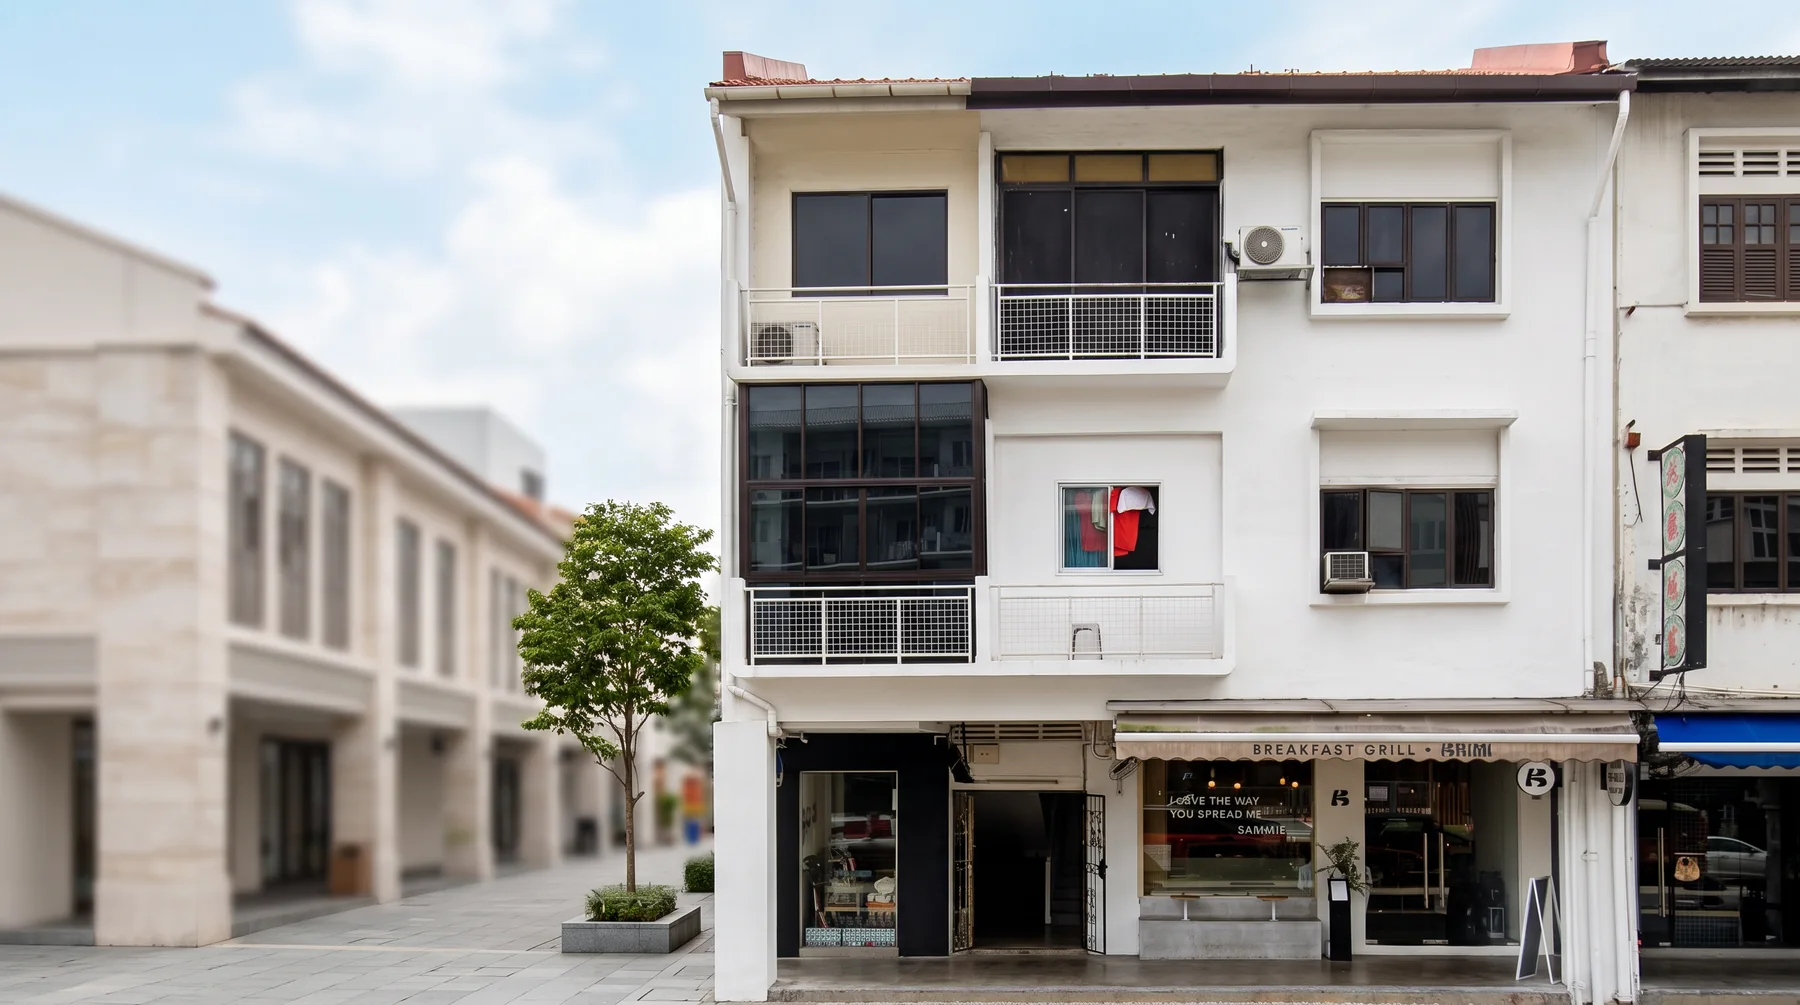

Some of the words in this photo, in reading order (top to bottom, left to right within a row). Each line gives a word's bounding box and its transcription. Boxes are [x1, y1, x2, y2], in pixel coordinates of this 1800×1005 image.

[1253, 744, 1354, 756] BREAKFAST
[1364, 744, 1416, 756] GRILL
[1209, 796, 1232, 806] THE
[1234, 796, 1260, 806] WAY
[1170, 809, 1194, 819] YOU
[1198, 809, 1243, 819] SPREAD
[1246, 809, 1262, 819] ME
[1237, 825, 1286, 835] SAMMIE
